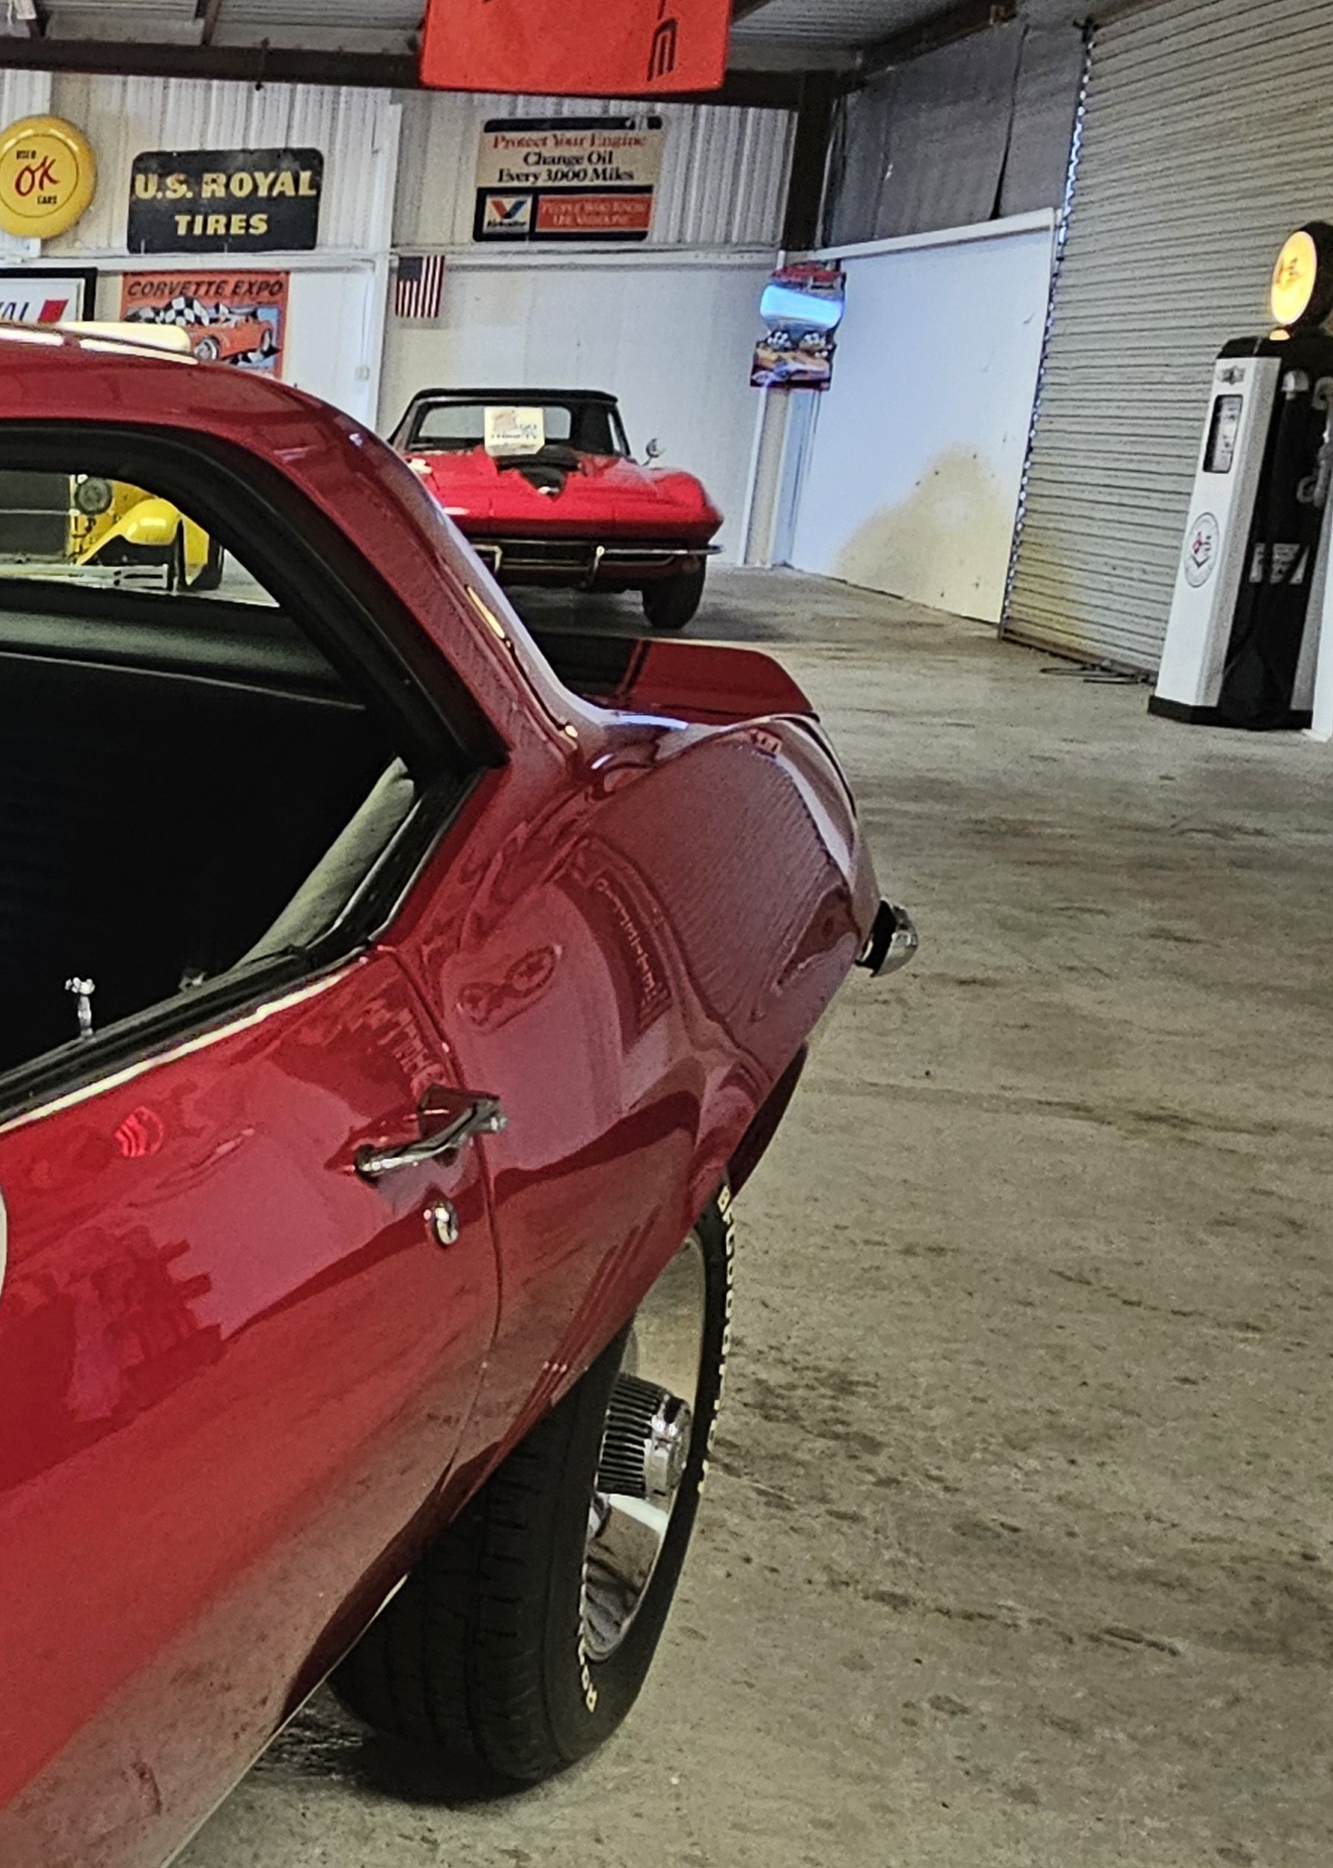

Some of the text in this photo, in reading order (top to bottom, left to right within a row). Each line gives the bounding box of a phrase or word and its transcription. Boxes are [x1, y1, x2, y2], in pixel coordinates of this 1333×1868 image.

[493, 132, 646, 149] Protect Your Engine
[523, 149, 613, 167] Change Oil
[15, 155, 60, 197] OK
[498, 168, 541, 184] Every
[591, 166, 634, 182] Miles
[134, 170, 317, 199] U.S. ROYAL
[37, 195, 57, 205] CARS
[174, 214, 269, 236] TIRES
[127, 279, 283, 297] CORVETTE EXPO
